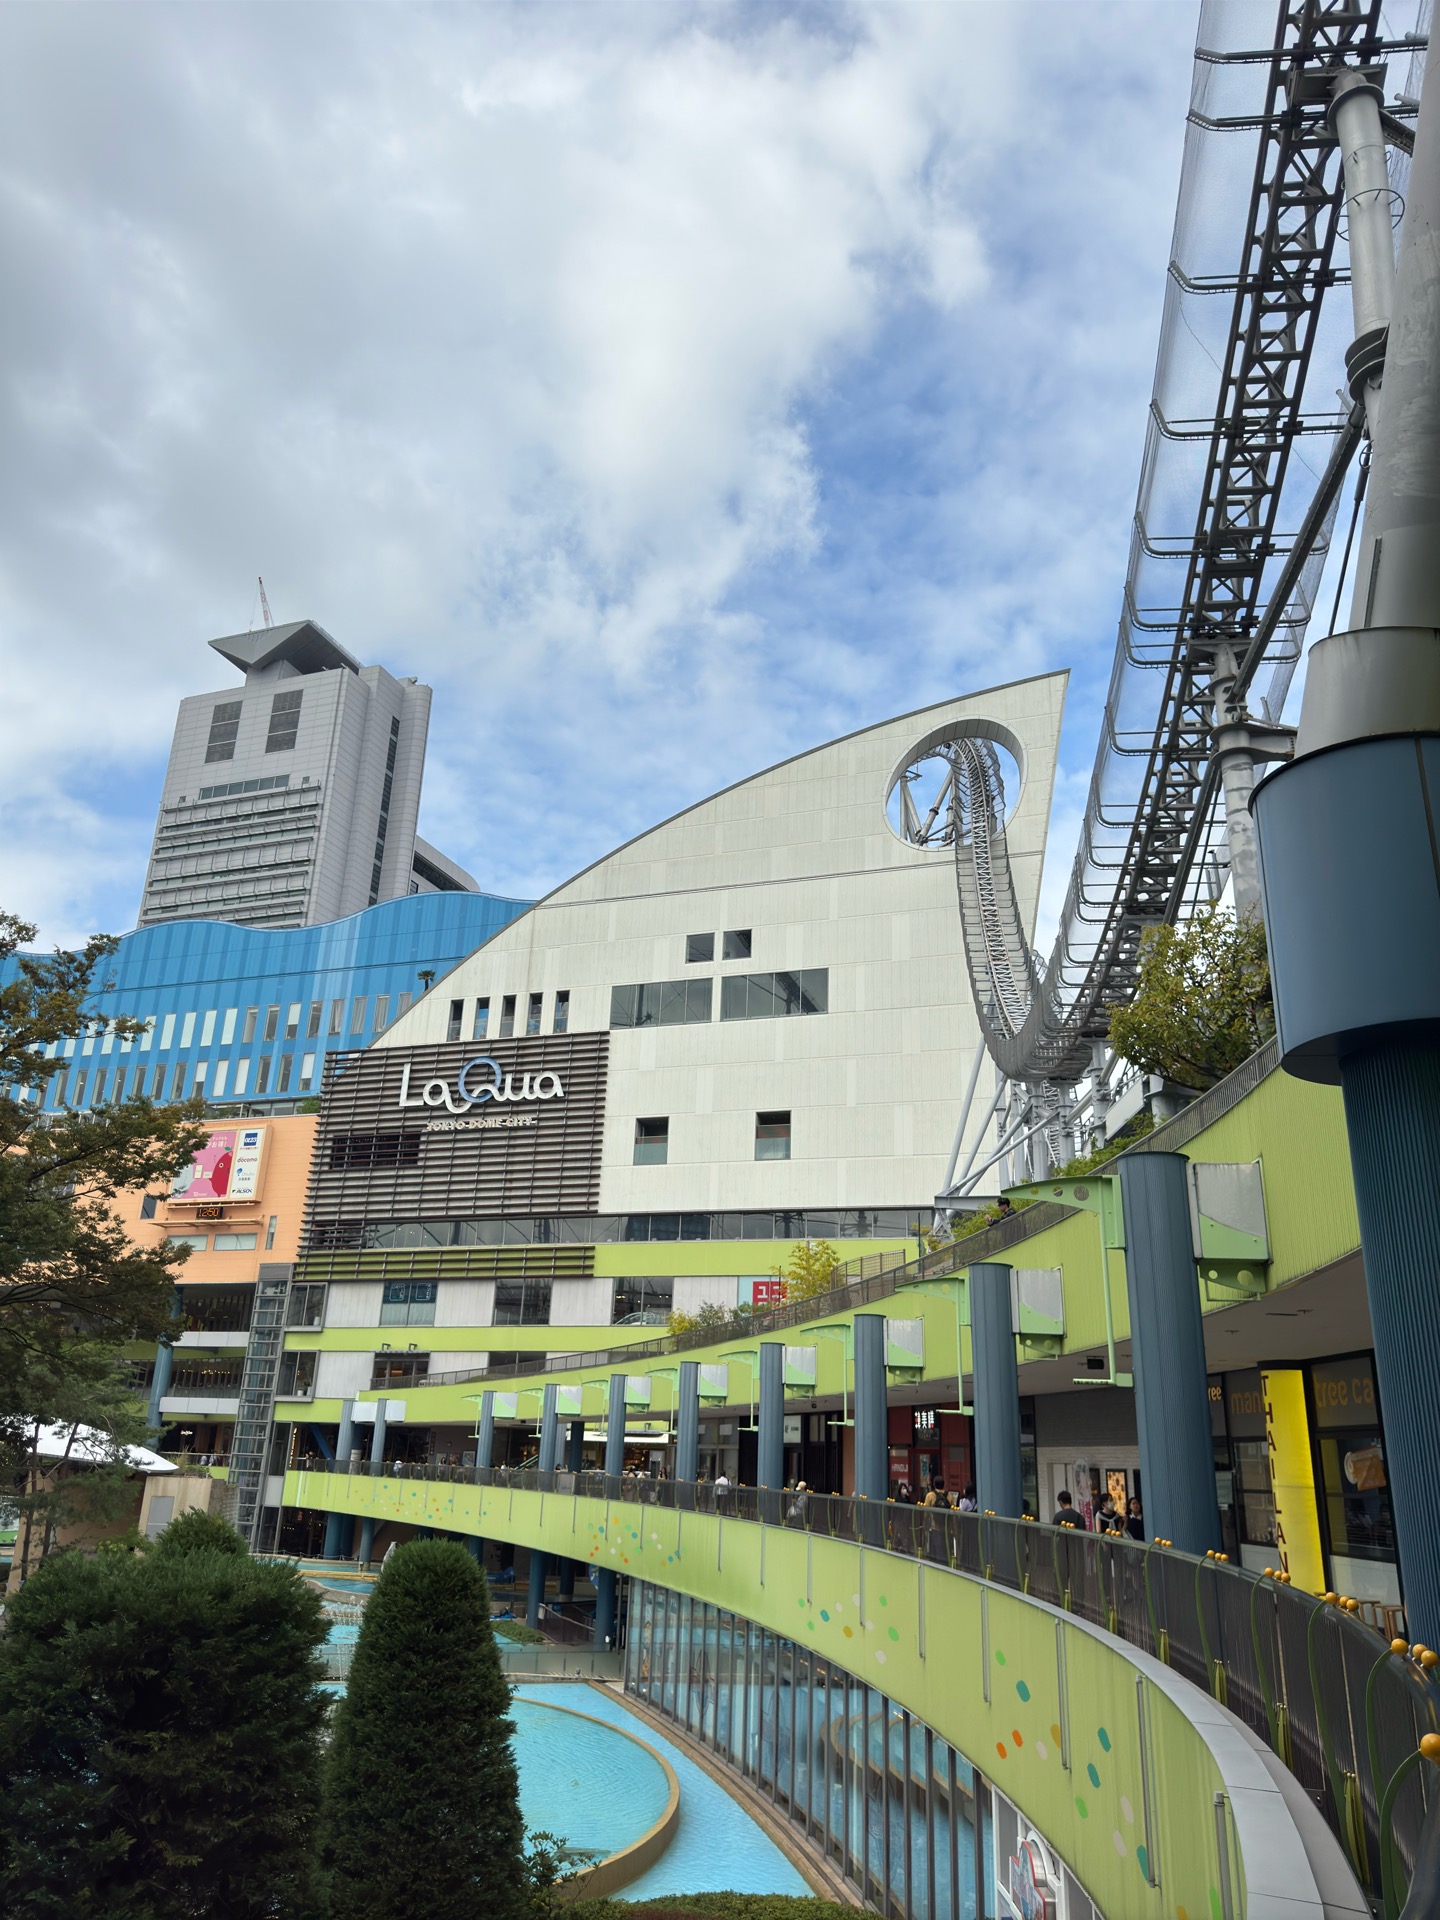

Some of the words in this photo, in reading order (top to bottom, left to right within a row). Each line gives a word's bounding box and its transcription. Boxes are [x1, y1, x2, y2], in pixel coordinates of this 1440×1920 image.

[399, 1056, 564, 1113] LaQua
[427, 1121, 465, 1131] TOKYO
[469, 1119, 502, 1129] DOME
[506, 1117, 532, 1127] CITY
[1313, 1380, 1349, 1408] tree
